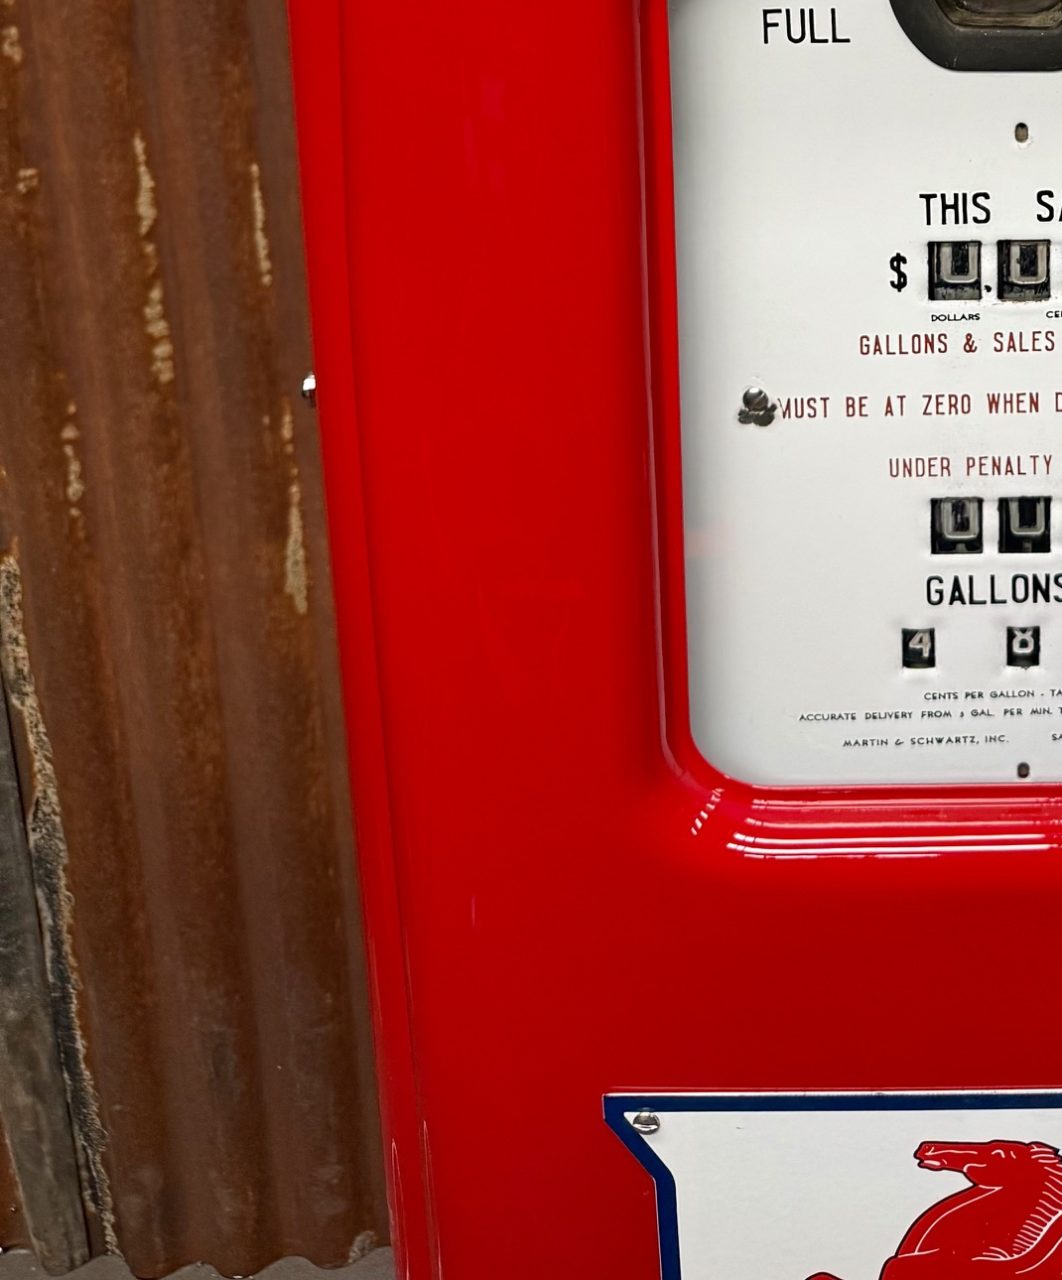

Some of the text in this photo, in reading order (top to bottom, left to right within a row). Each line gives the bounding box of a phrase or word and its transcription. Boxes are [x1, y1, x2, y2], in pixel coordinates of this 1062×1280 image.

[762, 8, 851, 44] FULL
[918, 191, 991, 226] THIS
[930, 312, 981, 323] DOLLARS
[859, 333, 948, 356] GALLONS
[963, 332, 978, 354] &
[993, 330, 1055, 353] SALES
[778, 396, 830, 419] MUST
[845, 395, 869, 418] BE
[884, 394, 907, 417] AT
[922, 393, 971, 416] ZERO
[986, 391, 1040, 414] WHEN
[889, 456, 951, 478] UNDER
[966, 454, 1052, 477] PENALTY
[923, 691, 959, 701] CENTS
[964, 691, 984, 700] PER
[989, 689, 1035, 699] GALLON
[799, 712, 857, 722] ACCURATE
[864, 711, 913, 720] DELIVERY
[920, 710, 952, 719] FROM
[1003, 708, 1023, 717] PER
[842, 738, 889, 747] MARTIN
[910, 735, 980, 746] SCHWARTZ,
[984, 734, 1010, 744] INC.
